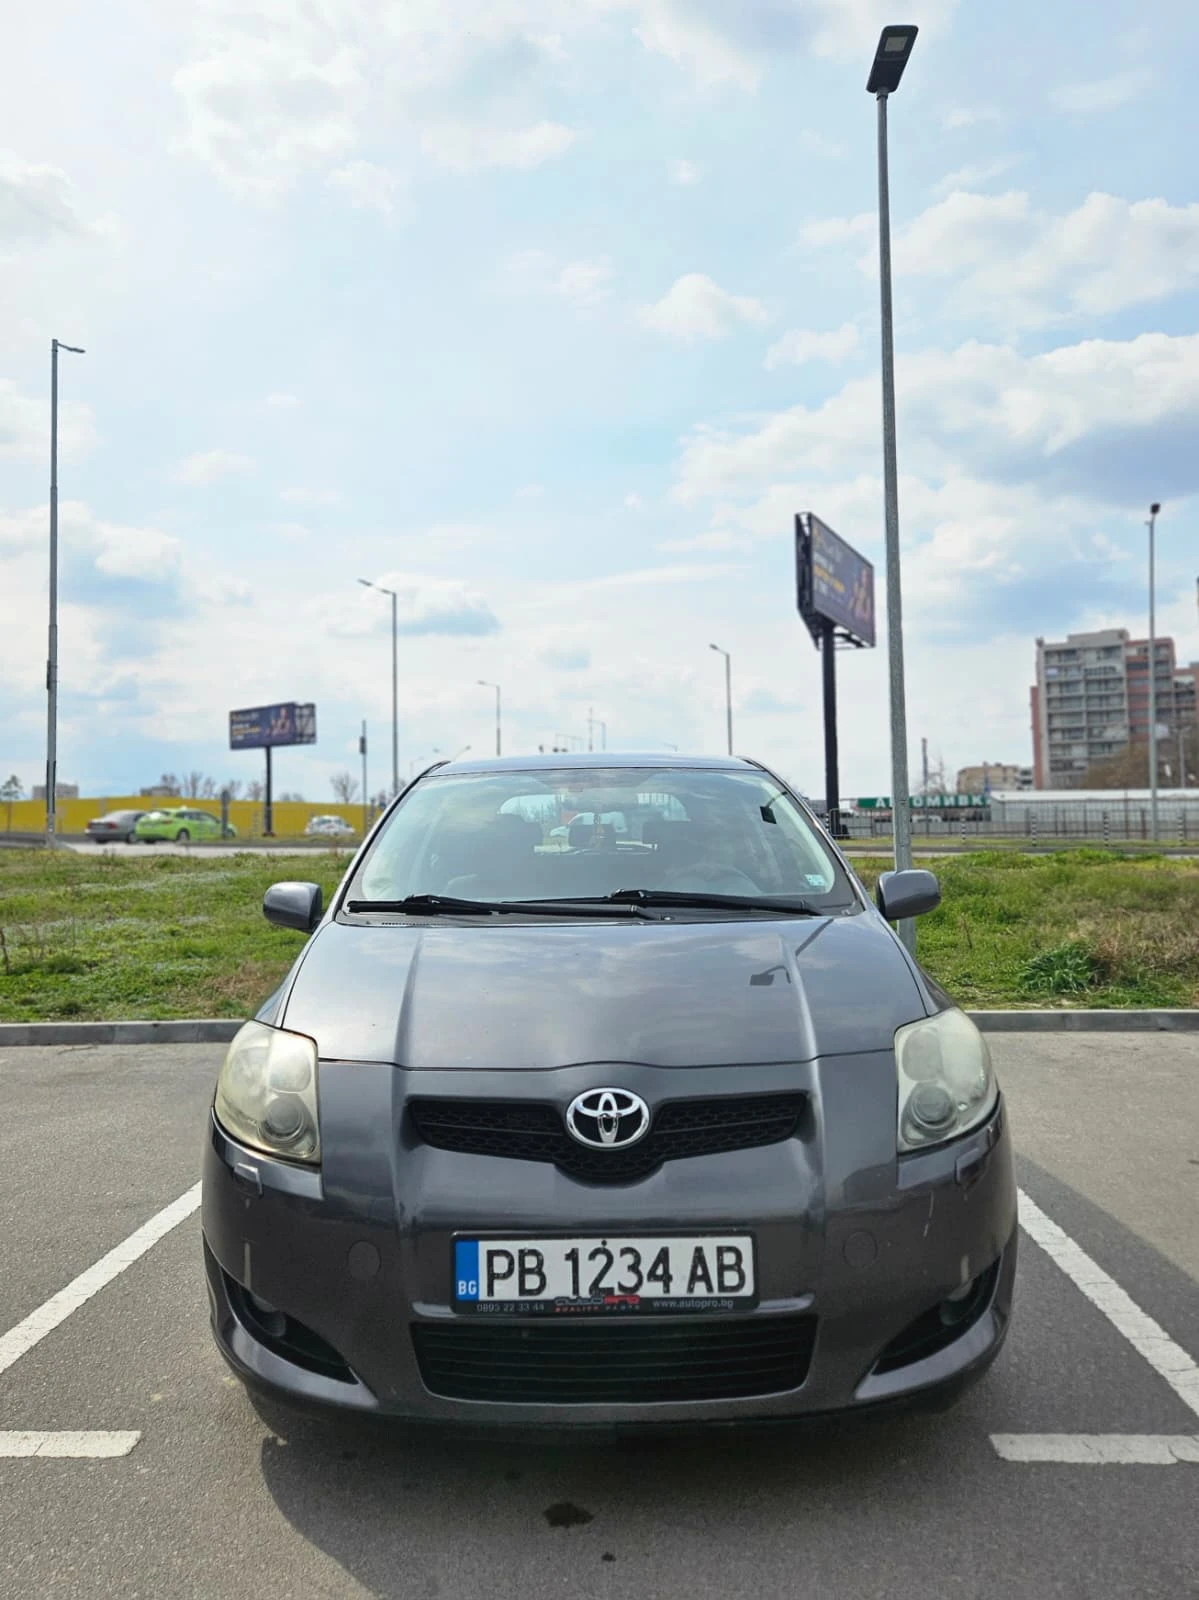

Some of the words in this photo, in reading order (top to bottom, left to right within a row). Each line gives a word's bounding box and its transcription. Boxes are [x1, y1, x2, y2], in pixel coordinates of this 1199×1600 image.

[875, 794, 991, 808] АОМИВК
[486, 1247, 547, 1298] PB
[563, 1246, 674, 1298] 1234
[686, 1245, 747, 1295] AB
[457, 1279, 478, 1297] BG
[652, 1298, 735, 1311] www.autopro.bg
